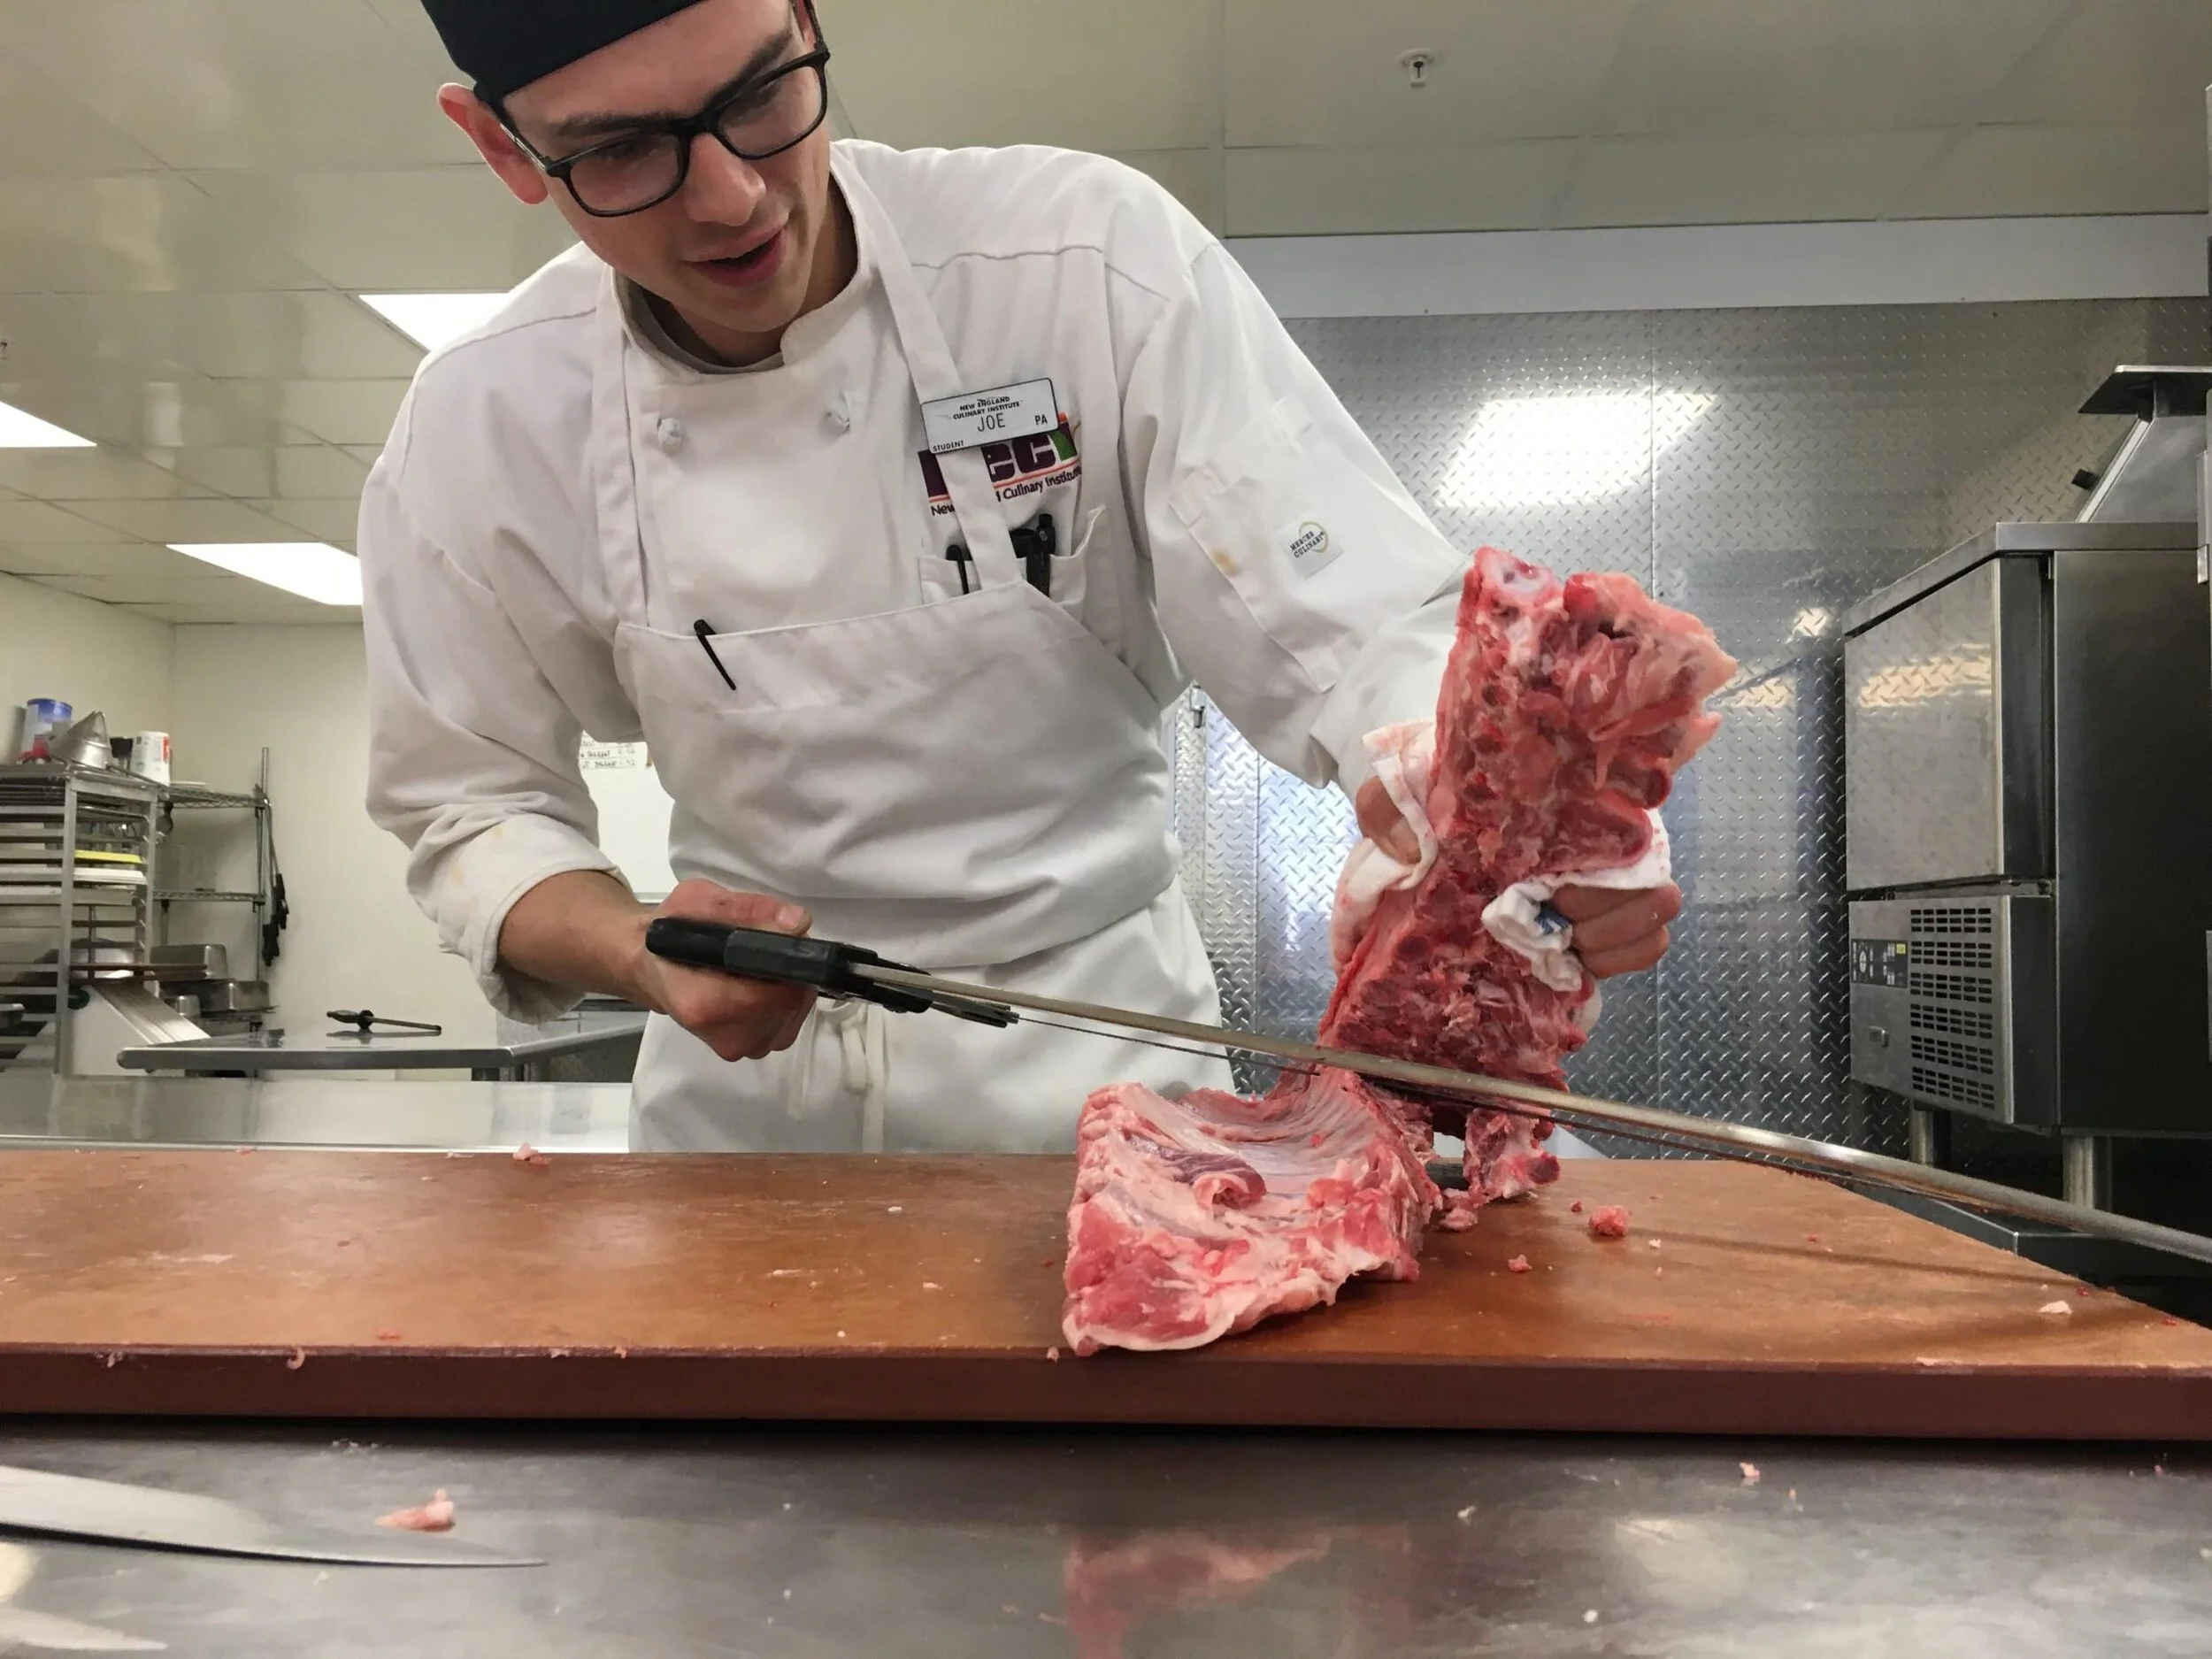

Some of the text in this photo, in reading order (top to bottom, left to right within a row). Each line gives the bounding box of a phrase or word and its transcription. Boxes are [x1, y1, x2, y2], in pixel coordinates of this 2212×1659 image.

[953, 401, 1020, 419] CULINARY INSTITUTE
[959, 396, 1010, 411] NEW ENGLAND
[977, 412, 1048, 432] JOE PA
[933, 440, 964, 452] STUDENT
[1002, 480, 1043, 500] Culinary
[1044, 465, 1082, 487] Institute
